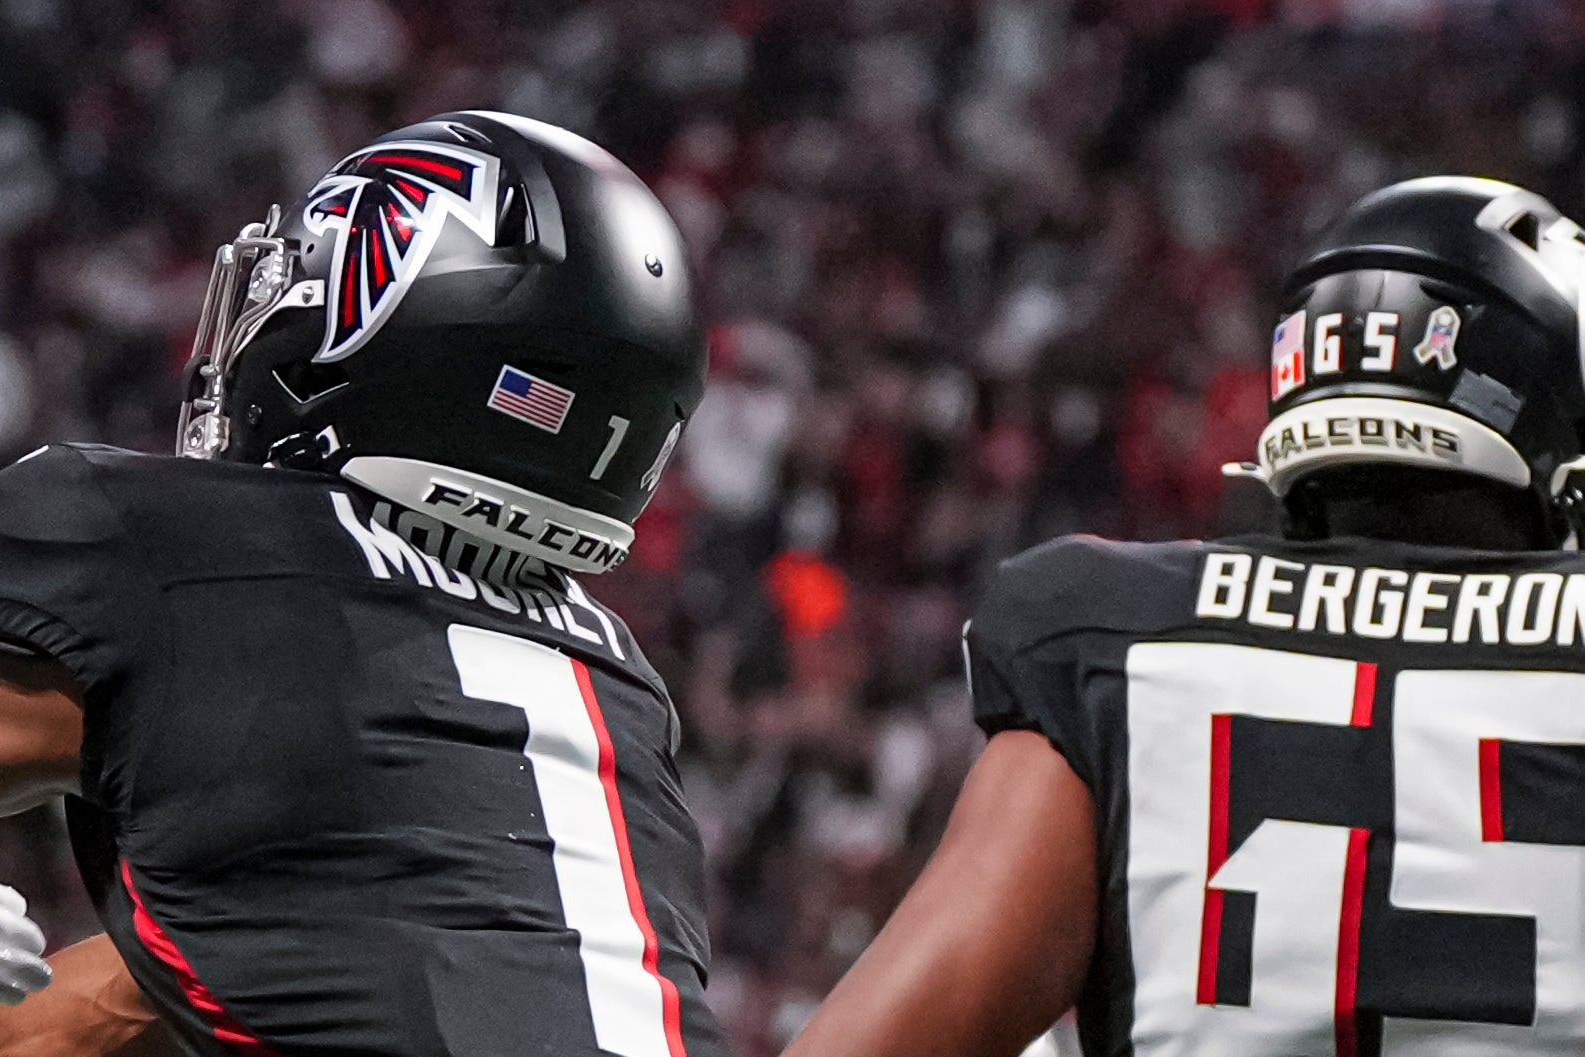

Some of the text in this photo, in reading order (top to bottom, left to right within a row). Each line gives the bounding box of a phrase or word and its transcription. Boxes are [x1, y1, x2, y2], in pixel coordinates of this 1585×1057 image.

[1314, 312, 1402, 376] 65
[590, 415, 631, 480] 1
[1265, 417, 1460, 462] FALCONS
